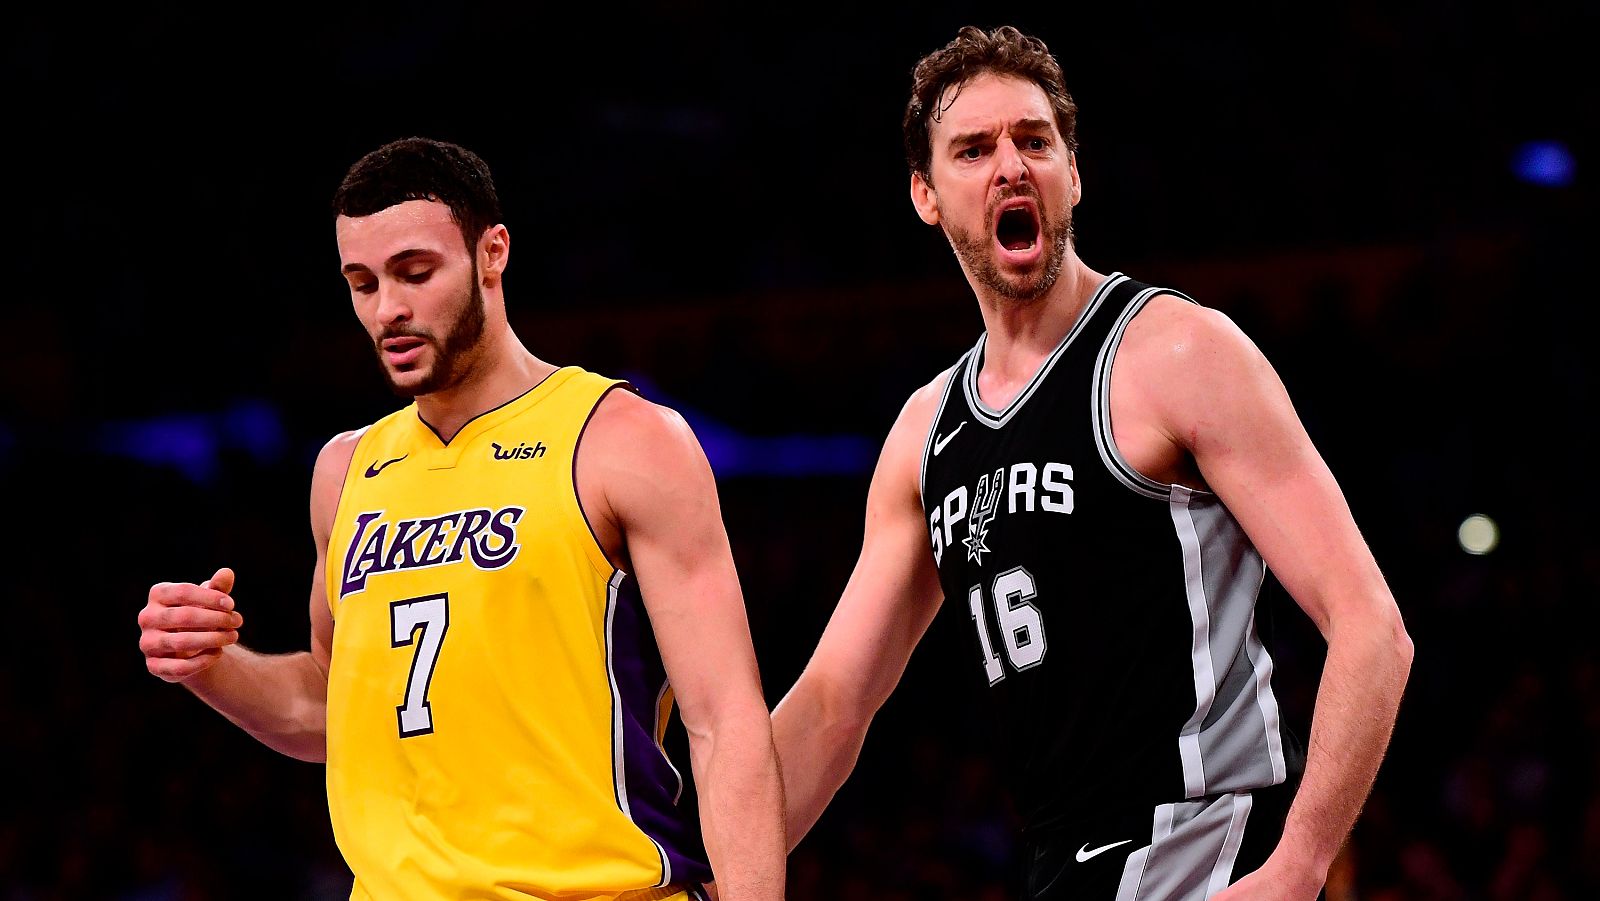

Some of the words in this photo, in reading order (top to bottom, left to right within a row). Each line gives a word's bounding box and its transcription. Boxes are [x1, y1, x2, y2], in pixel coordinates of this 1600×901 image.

[491, 442, 547, 460] wish
[340, 506, 527, 599] LAKERS
[930, 462, 1074, 568] SPURS
[390, 592, 450, 738] 7
[969, 565, 1047, 687] 16
